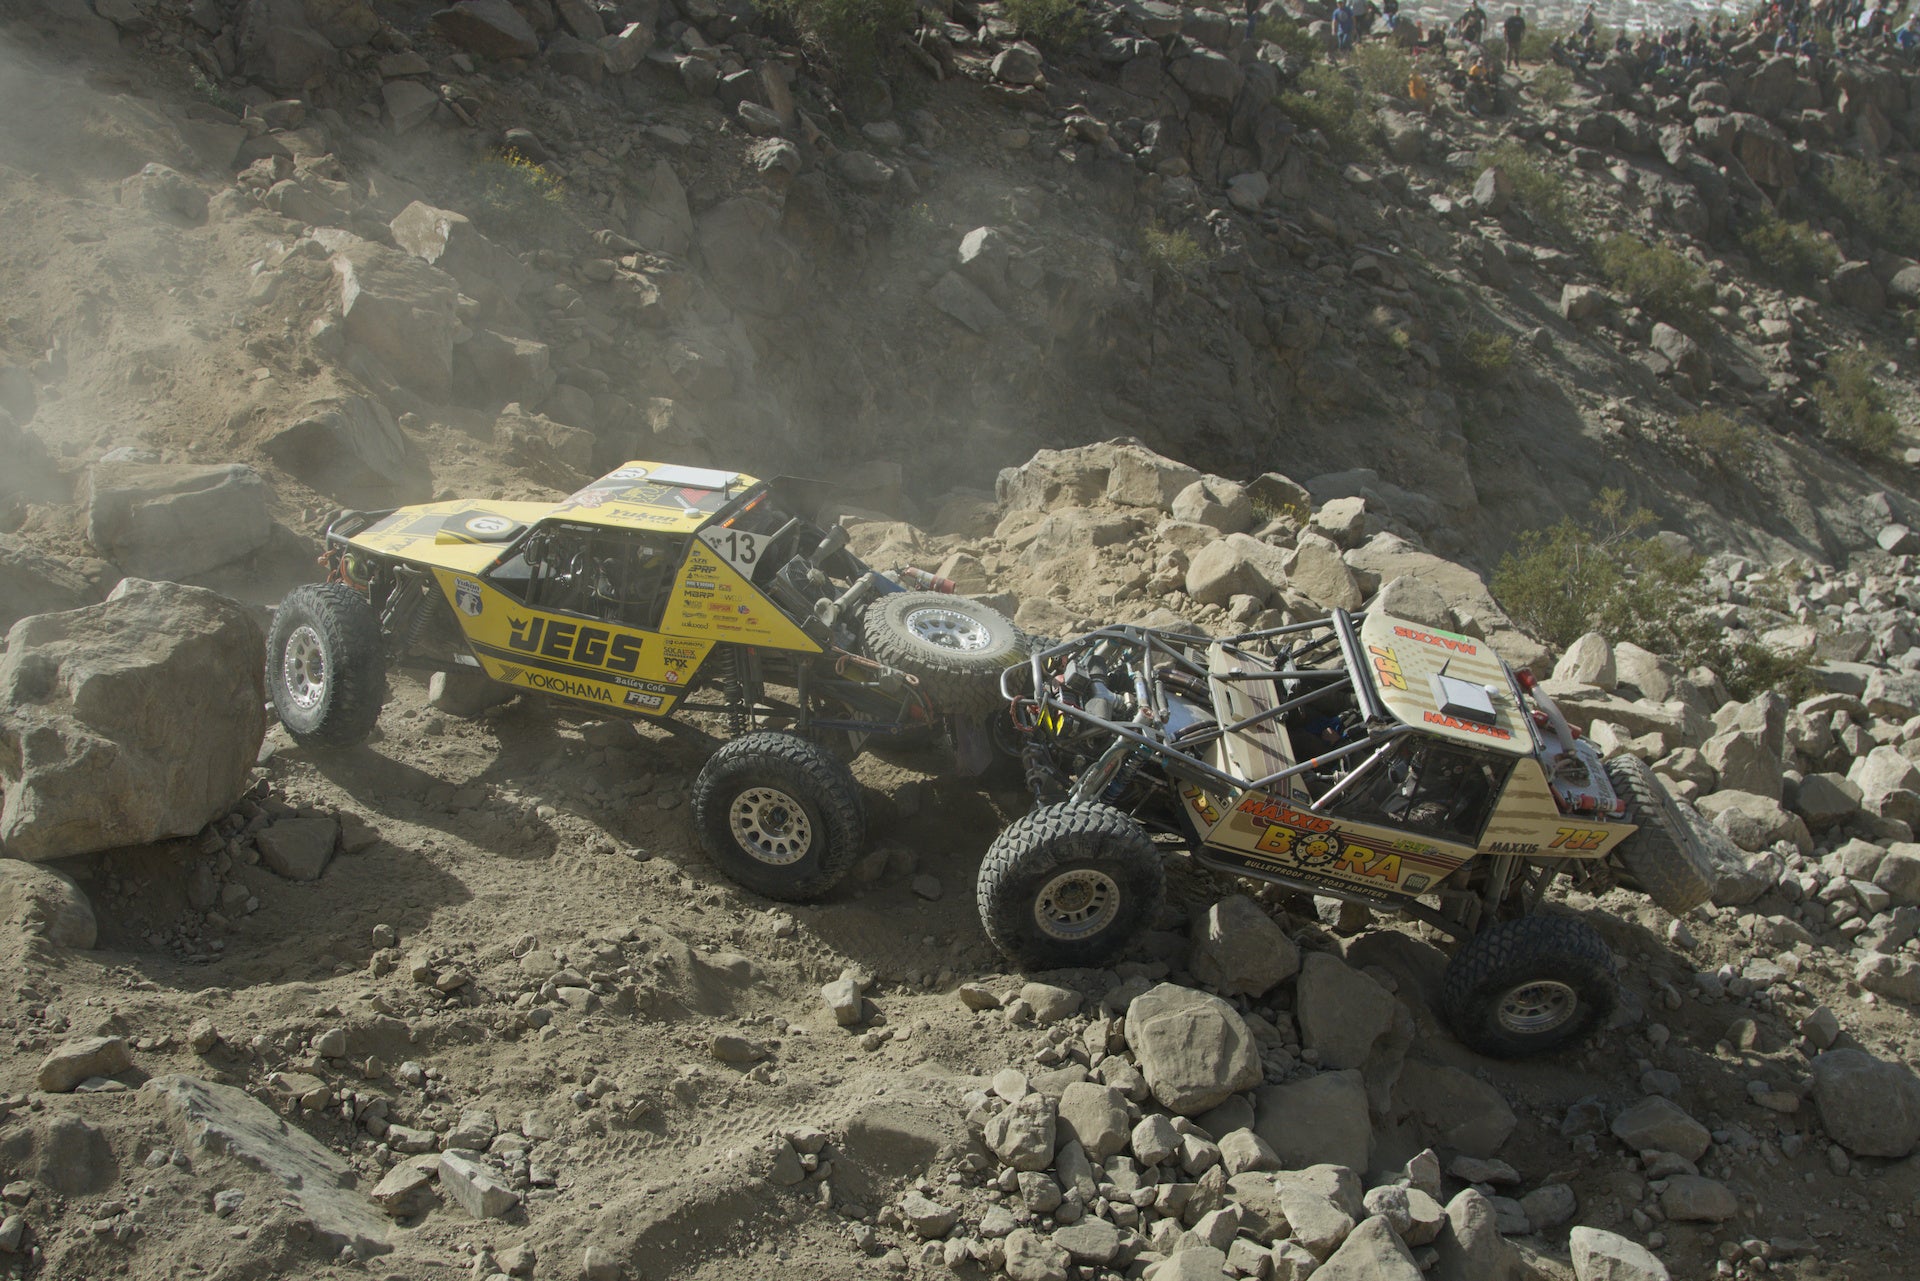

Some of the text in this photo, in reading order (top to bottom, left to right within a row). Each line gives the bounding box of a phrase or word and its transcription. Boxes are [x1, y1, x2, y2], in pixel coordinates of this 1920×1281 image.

[474, 518, 504, 531] 13
[725, 531, 756, 564] 13
[688, 564, 717, 574] PRP
[456, 578, 480, 592] Yukon
[684, 590, 714, 599] MBRP
[508, 616, 643, 673] JEGS
[1393, 625, 1477, 656] MAXXIS
[664, 657, 688, 669] FOX
[1368, 644, 1409, 691] 792
[524, 671, 615, 703] YOKOHAMA
[614, 676, 666, 693] Bailey Cole
[1423, 710, 1511, 741] MAXXIS
[1181, 784, 1220, 827] 792
[1236, 799, 1334, 833] MAXXIS
[1488, 841, 1540, 854] MAXXIS
[1549, 827, 1610, 850] 792
[1244, 860, 1303, 878] BULLETPROOF
[1345, 883, 1389, 900] ADAPTERS
[1333, 871, 1352, 880] MADE
[1364, 877, 1395, 890] AMERICA
